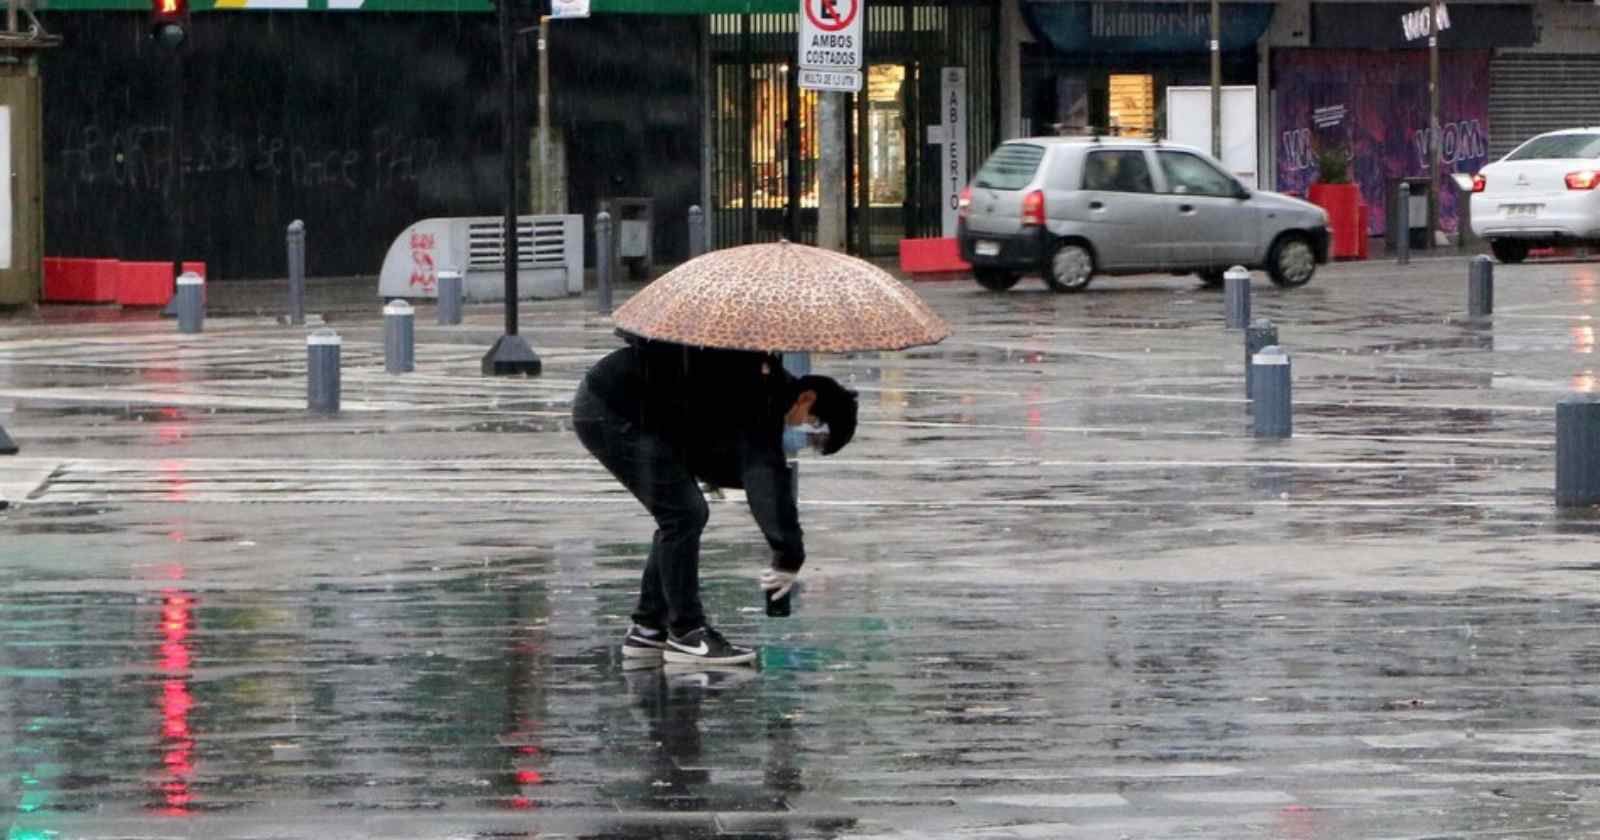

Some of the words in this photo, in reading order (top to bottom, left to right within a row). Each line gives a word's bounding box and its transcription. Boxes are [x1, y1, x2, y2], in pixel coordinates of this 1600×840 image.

[1402, 2, 1451, 41] WOM
[811, 34, 854, 48] AMBOS
[806, 50, 856, 65] COSTADOS
[949, 91, 960, 211] ABIERTO
